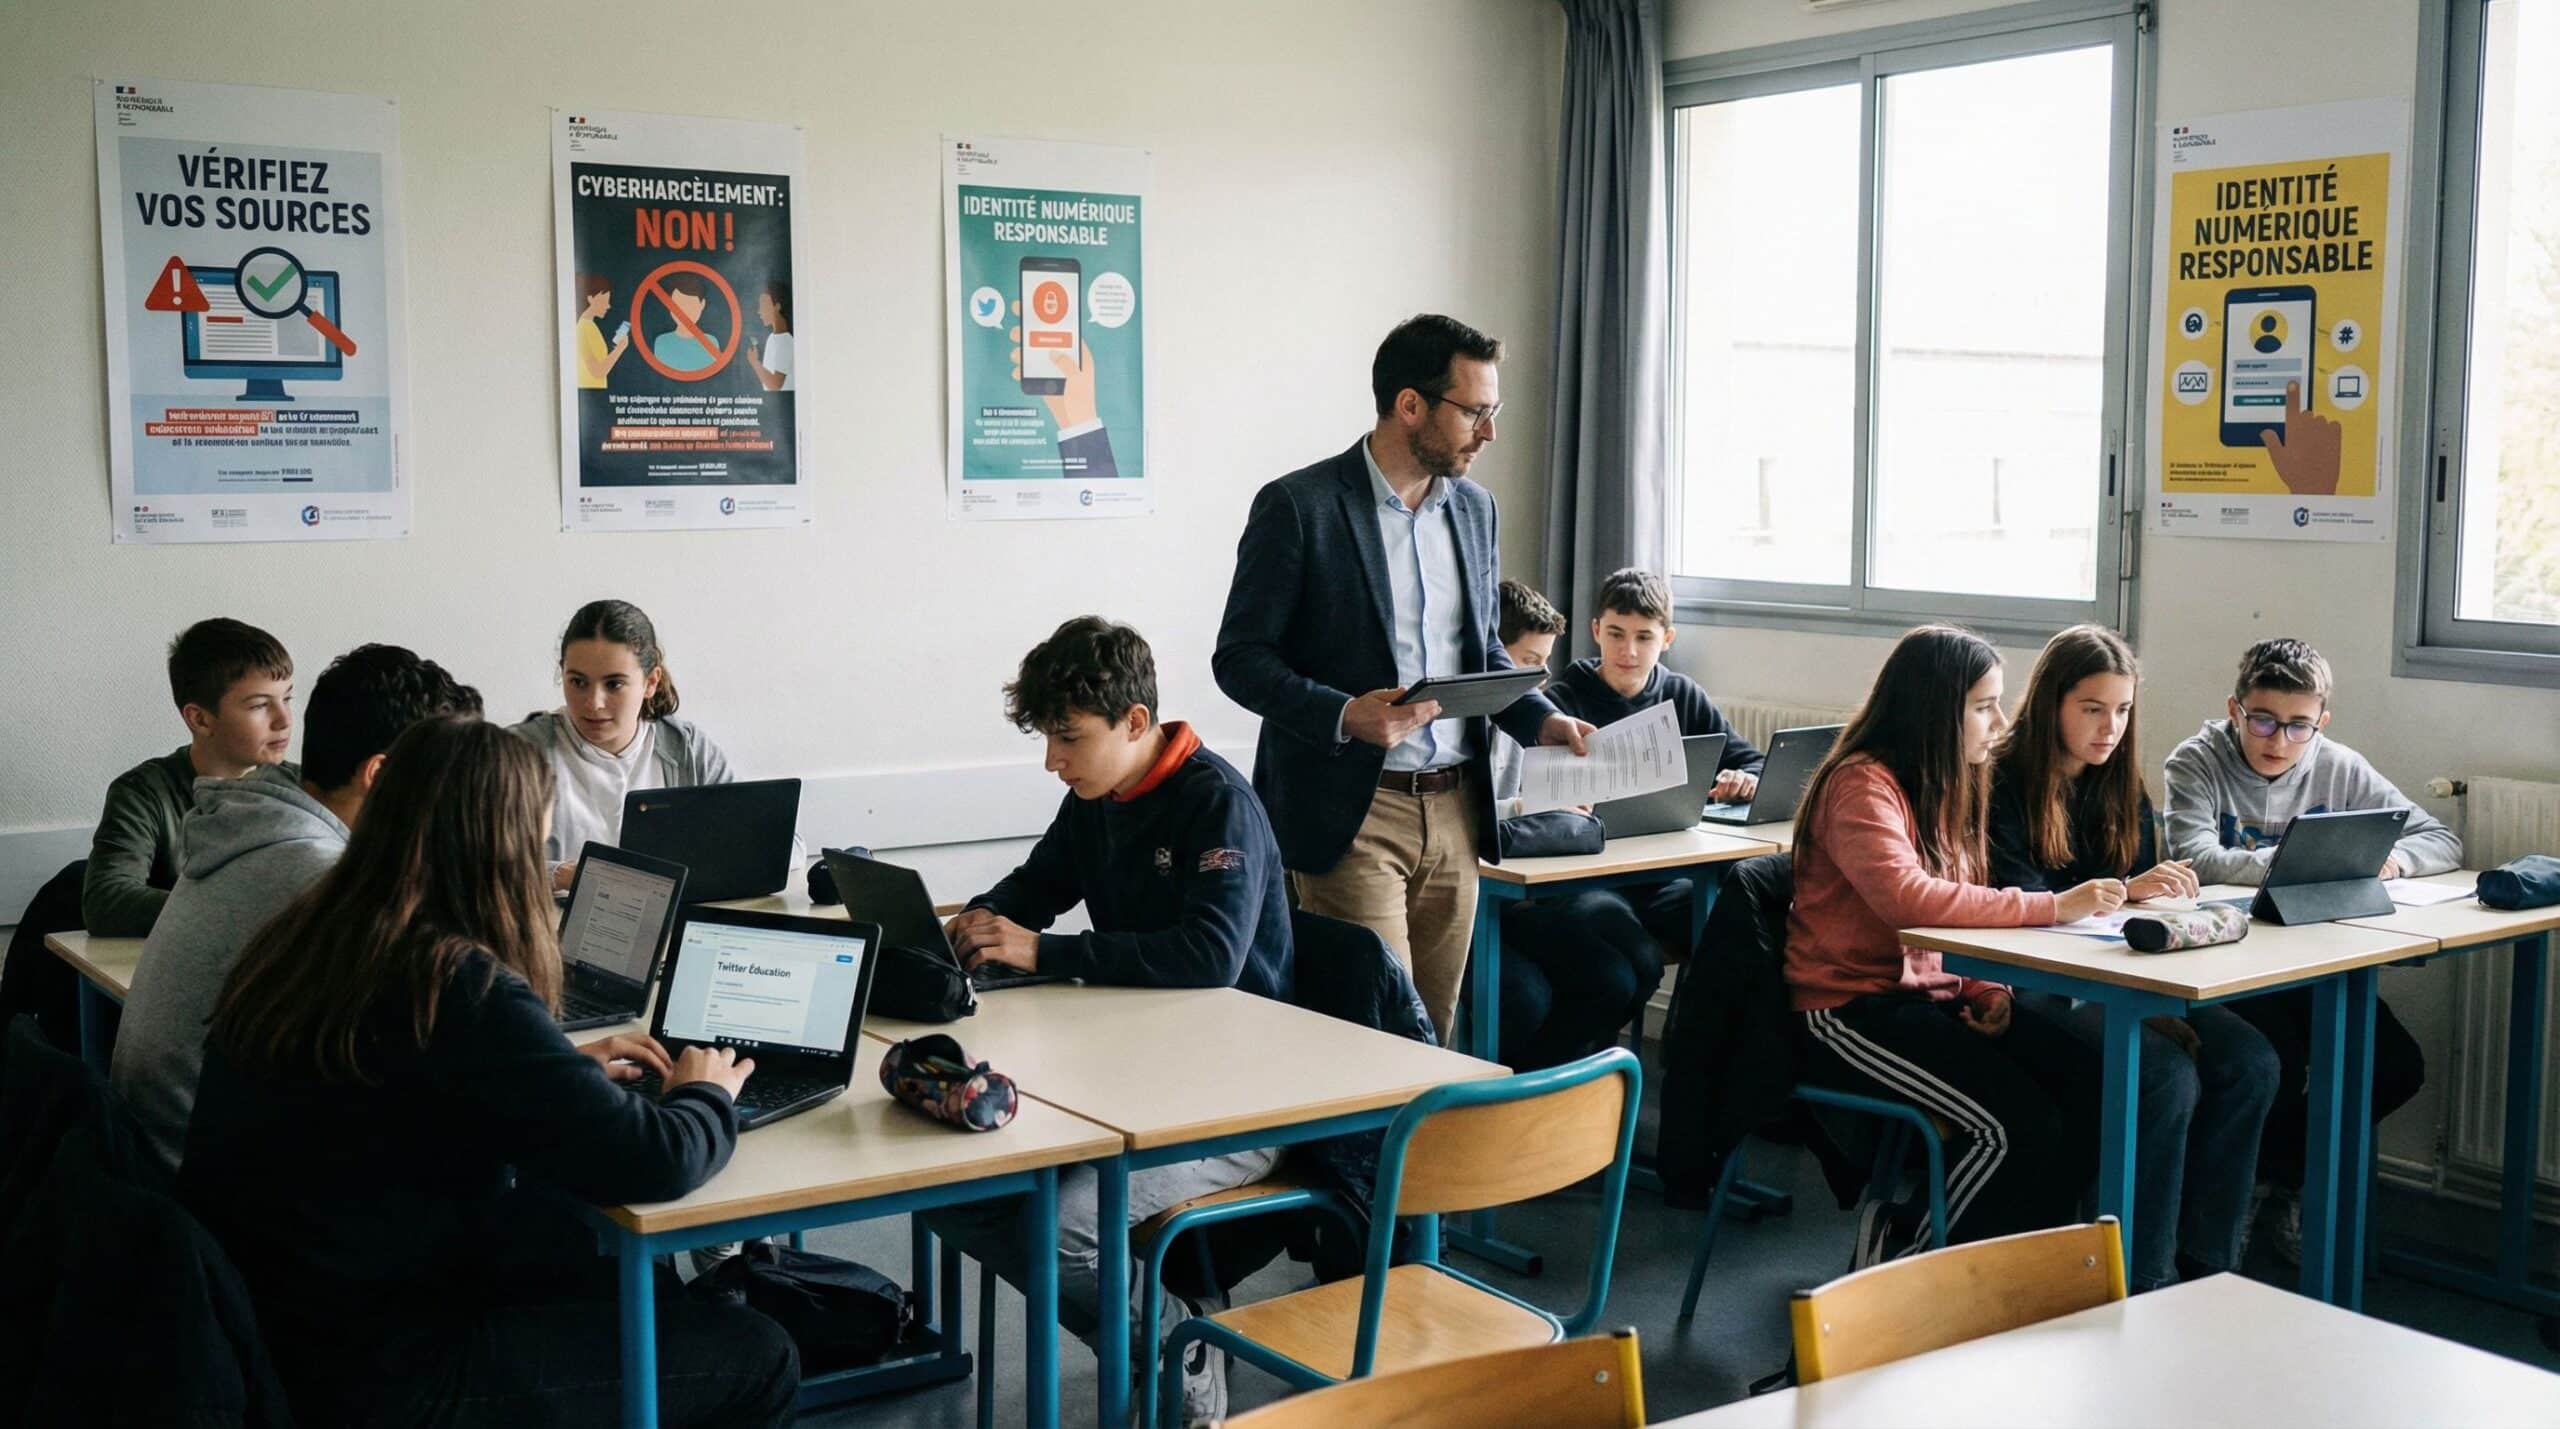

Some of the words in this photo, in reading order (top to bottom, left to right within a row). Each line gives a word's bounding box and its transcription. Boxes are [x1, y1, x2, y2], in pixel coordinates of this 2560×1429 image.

[177, 147, 329, 194] VÉRIFIEZ
[2216, 163, 2338, 211] IDENTITÉ
[135, 191, 206, 228] VOS
[215, 196, 371, 236] SOURCES
[636, 208, 716, 250] NON
[964, 194, 1037, 219] IDENTITÉ
[1041, 197, 1136, 225] NUMÉRIQUE
[2195, 204, 2359, 246] NUMÉRIQUE
[994, 221, 1109, 246] RESPONSABLE
[2180, 240, 2373, 281] RESPONSABLE
[718, 961, 747, 973] Twitter
